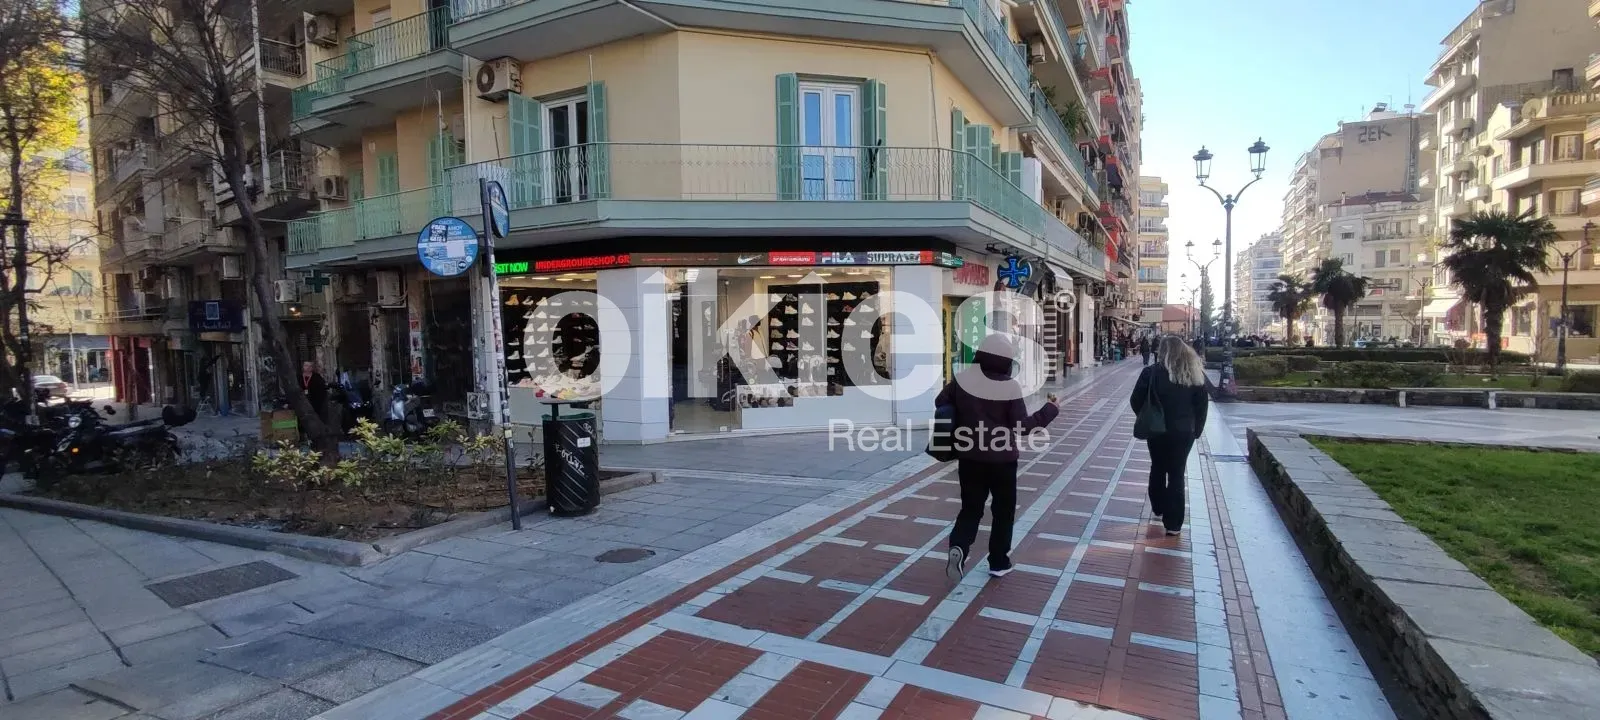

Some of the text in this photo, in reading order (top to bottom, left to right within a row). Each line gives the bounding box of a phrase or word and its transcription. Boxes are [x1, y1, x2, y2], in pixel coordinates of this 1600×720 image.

[510, 261, 529, 273] NOW
[535, 255, 629, 270] UNDERGROUNDSHOP.GR
[821, 252, 855, 264] FILA
[867, 252, 903, 264] SUPRA
